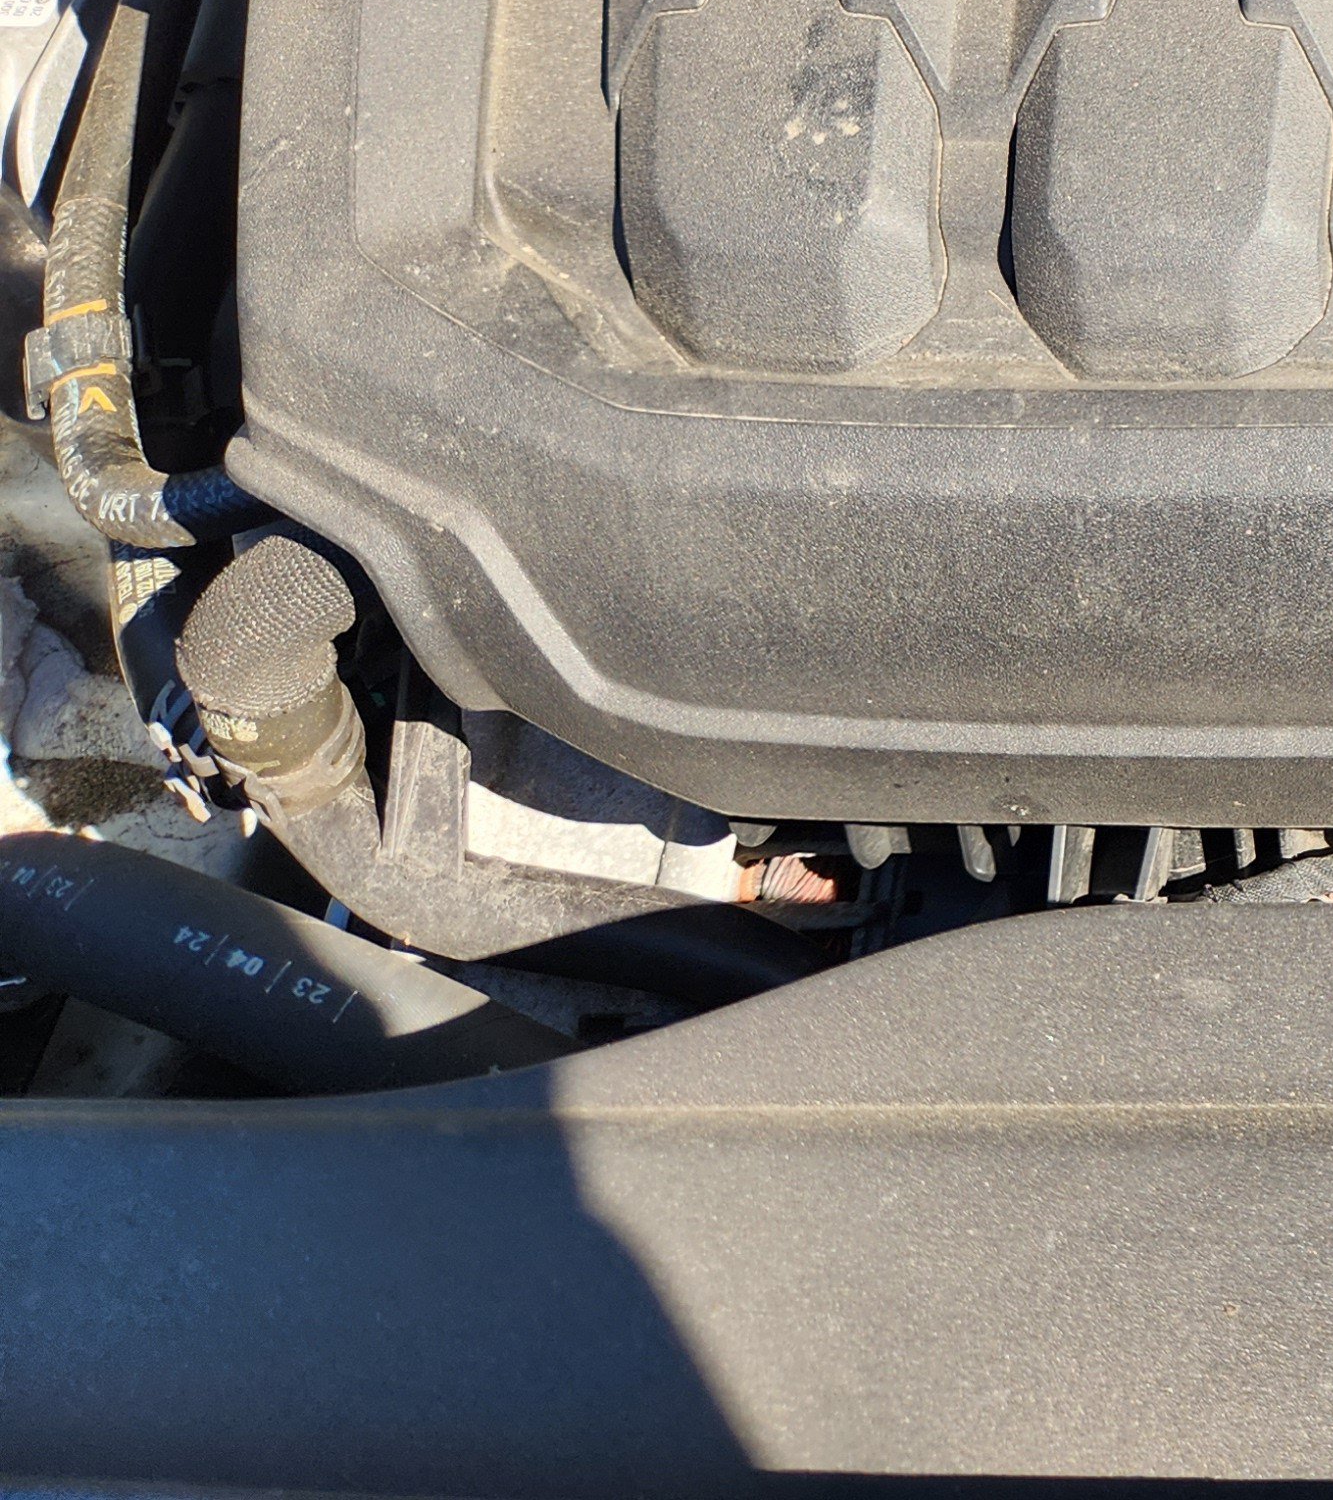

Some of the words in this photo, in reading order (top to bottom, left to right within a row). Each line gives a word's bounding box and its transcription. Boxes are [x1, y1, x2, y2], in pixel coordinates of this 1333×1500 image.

[99, 491, 141, 523] VRT
[173, 925, 212, 952] 24
[225, 948, 264, 976] 04
[291, 976, 332, 1005] 23
